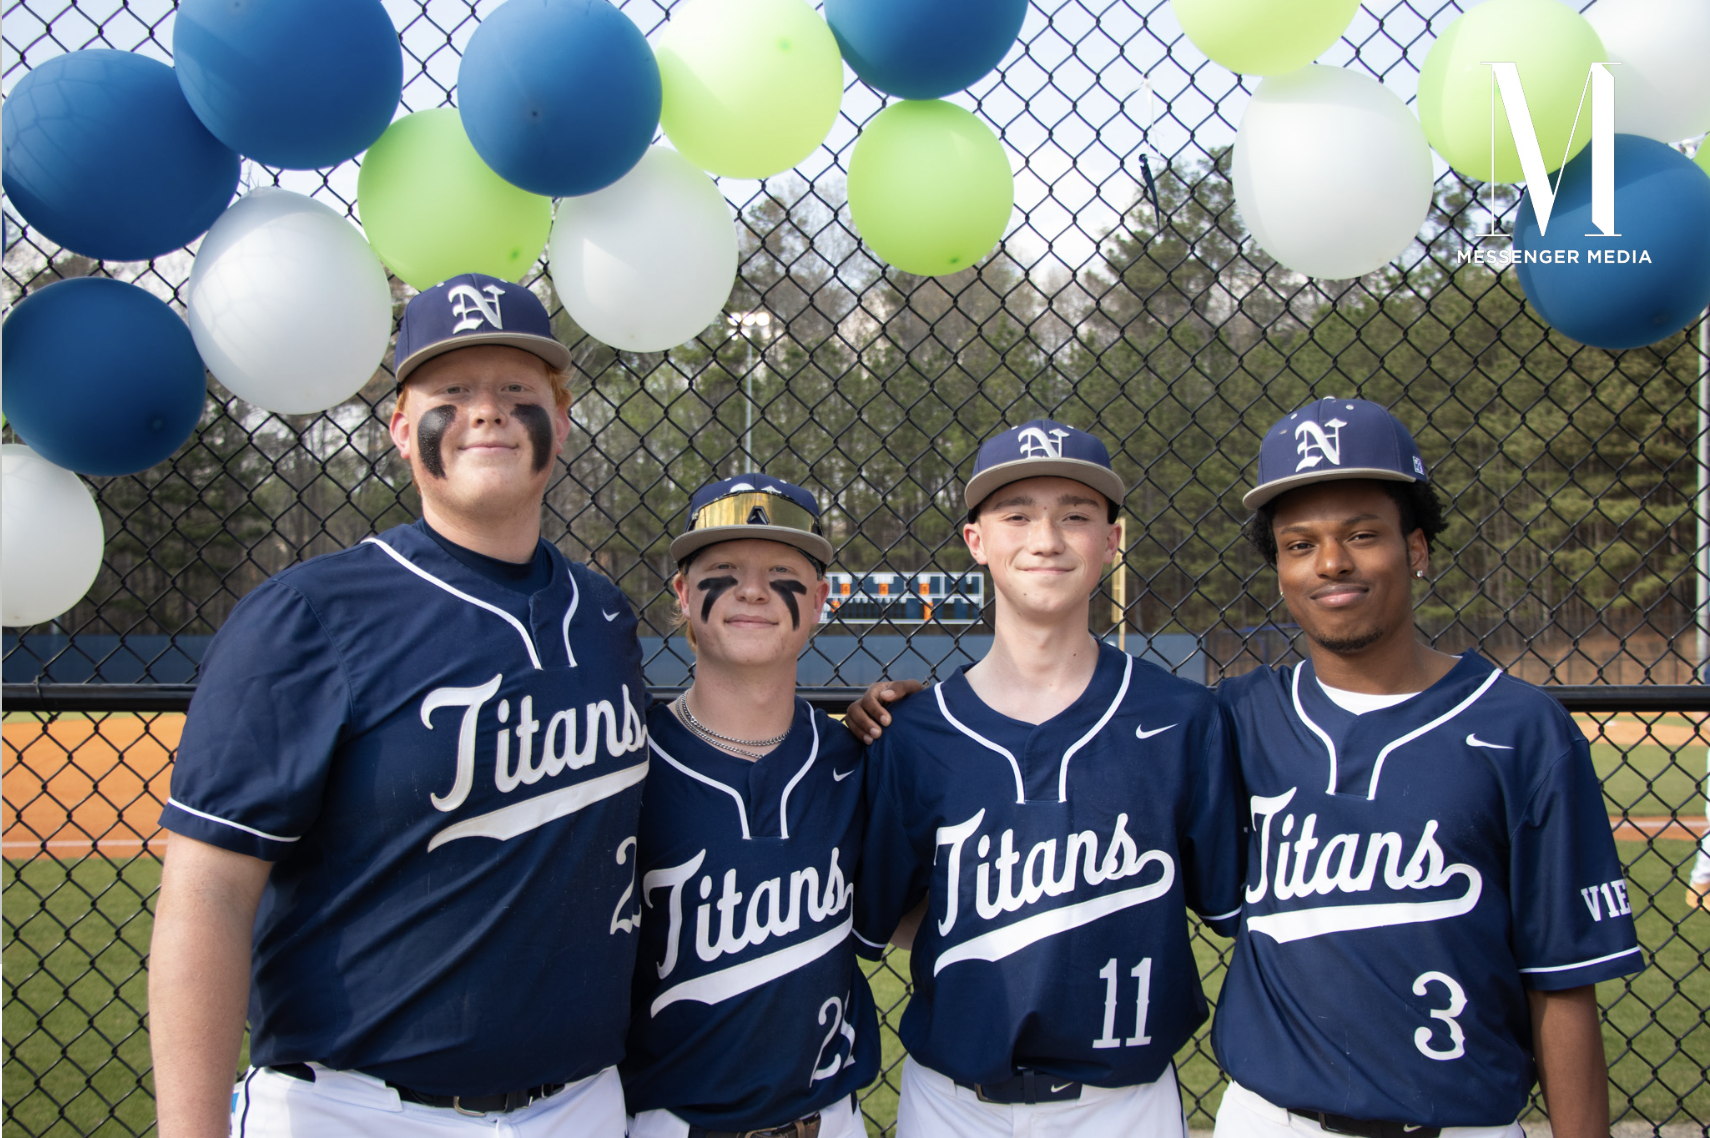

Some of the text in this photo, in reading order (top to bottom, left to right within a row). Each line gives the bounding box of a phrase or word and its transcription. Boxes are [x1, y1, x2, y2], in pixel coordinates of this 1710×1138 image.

[448, 284, 506, 335] N
[1294, 418, 1348, 473] N
[420, 673, 649, 813] Titans
[933, 808, 1140, 938] Titans
[1245, 786, 1450, 904] Titans
[643, 847, 855, 980] Titans
[1092, 957, 1152, 1049] 11
[1412, 971, 1468, 1061] 3
